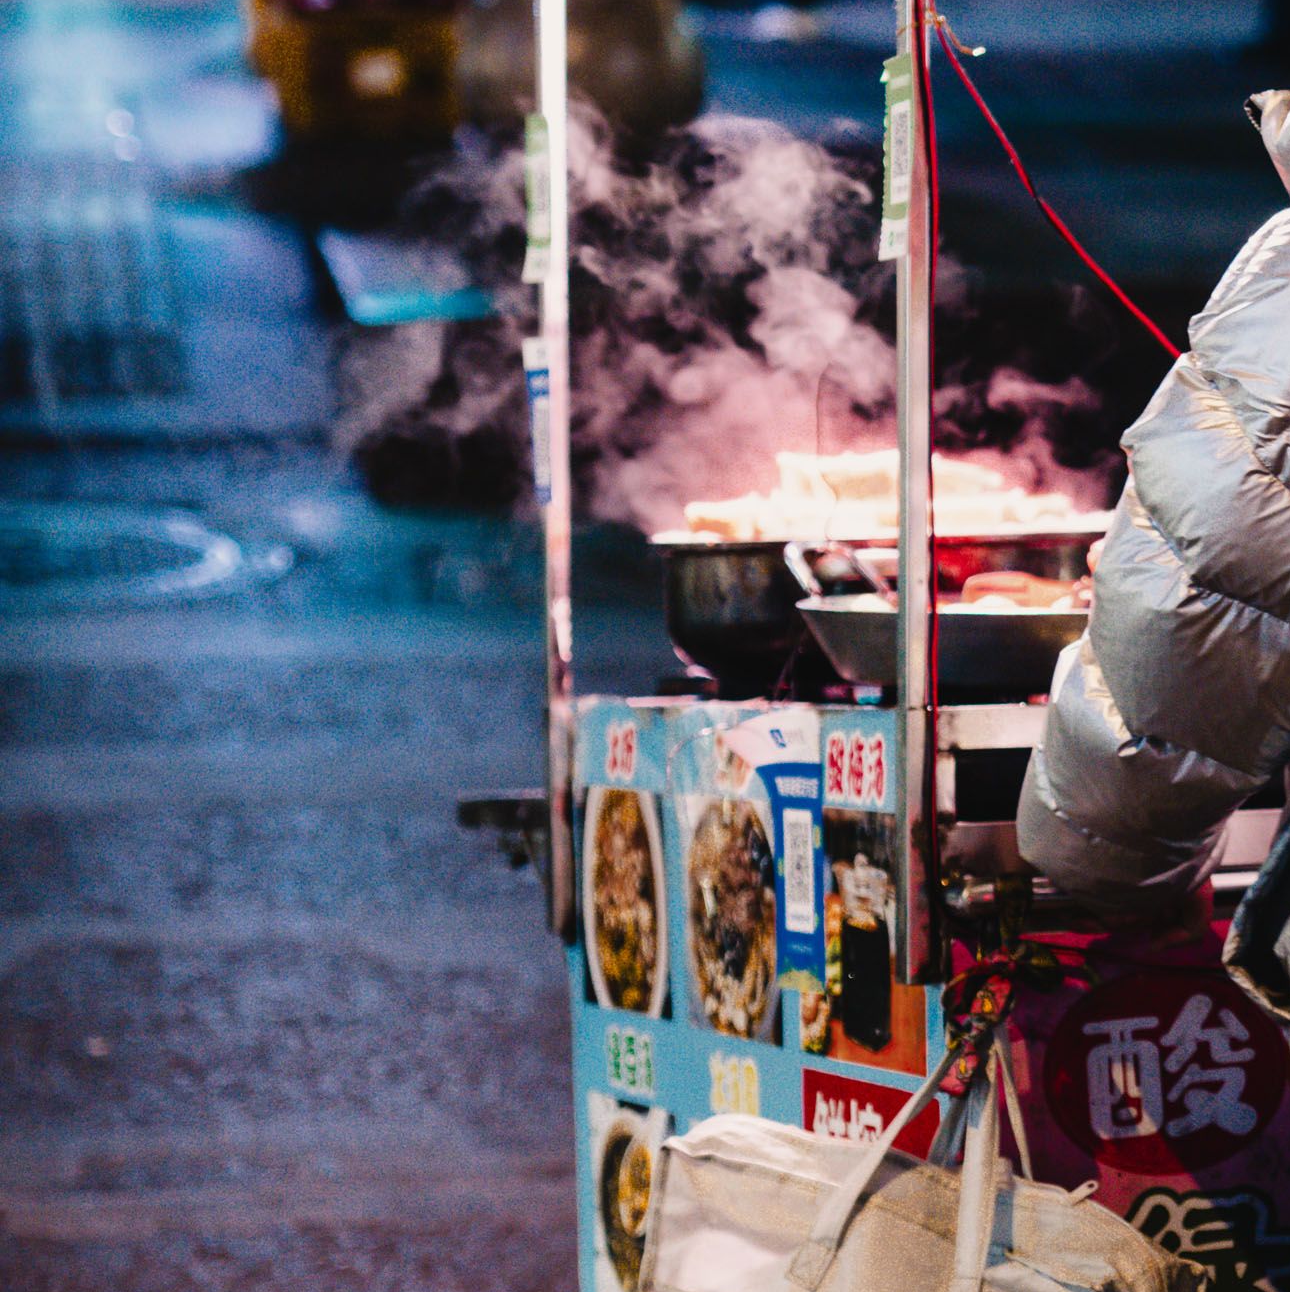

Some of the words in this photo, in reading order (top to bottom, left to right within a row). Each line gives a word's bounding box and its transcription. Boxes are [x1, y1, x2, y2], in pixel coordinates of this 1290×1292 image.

[826, 733, 885, 803] 酸梅汤
[1081, 993, 1259, 1141] 酸
